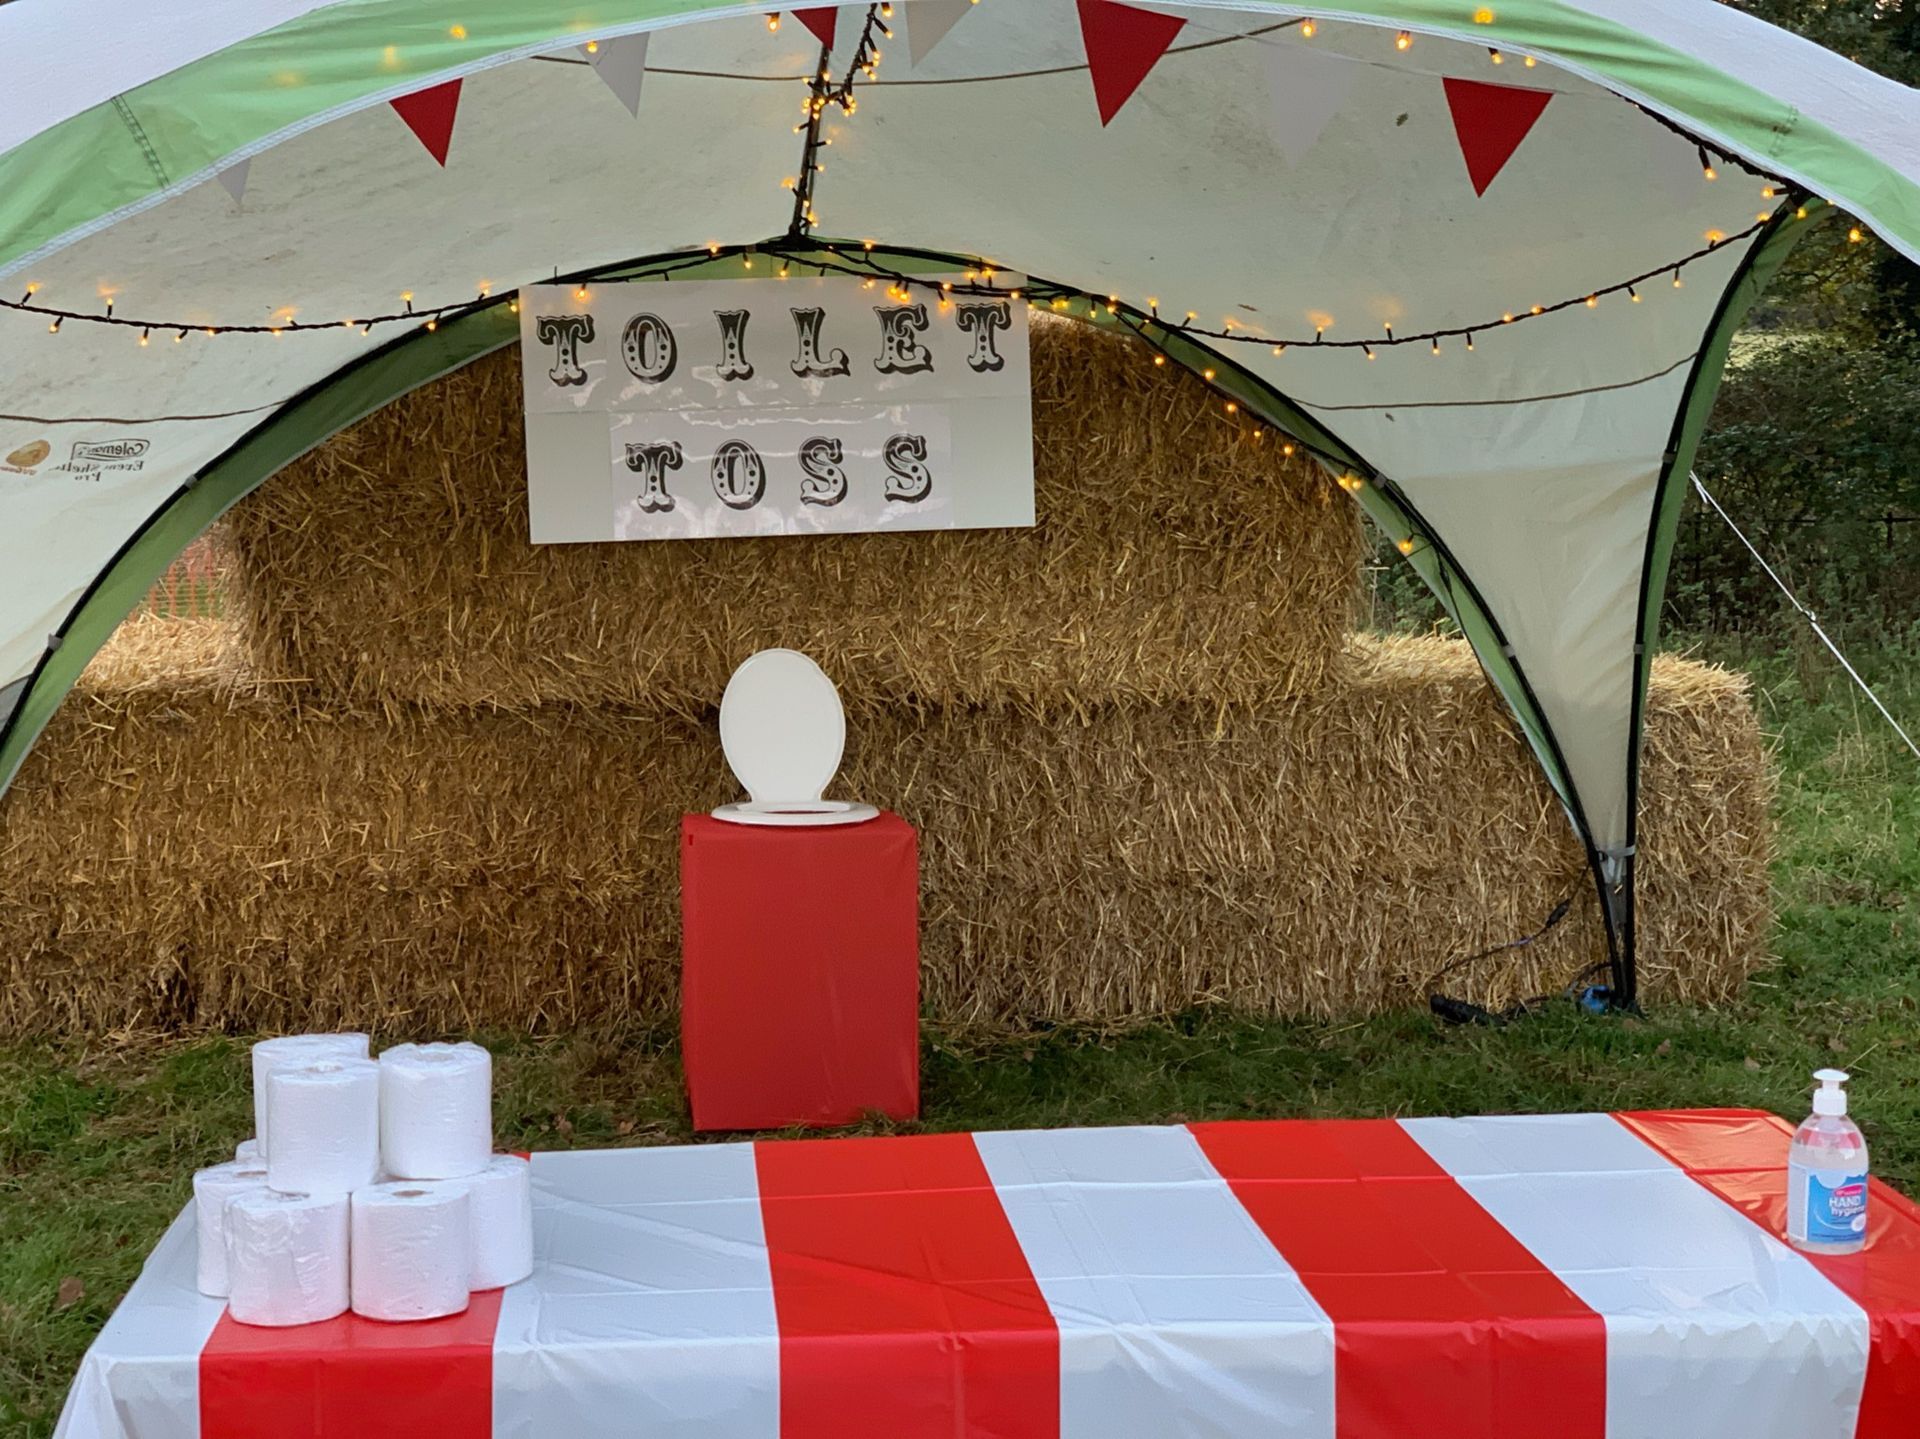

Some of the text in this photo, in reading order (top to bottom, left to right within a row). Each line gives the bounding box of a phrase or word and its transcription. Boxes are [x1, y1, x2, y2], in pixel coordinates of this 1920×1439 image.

[536, 302, 1012, 387] TOILET
[625, 433, 933, 513] TOSS
[1829, 1196, 1861, 1207] HAND
